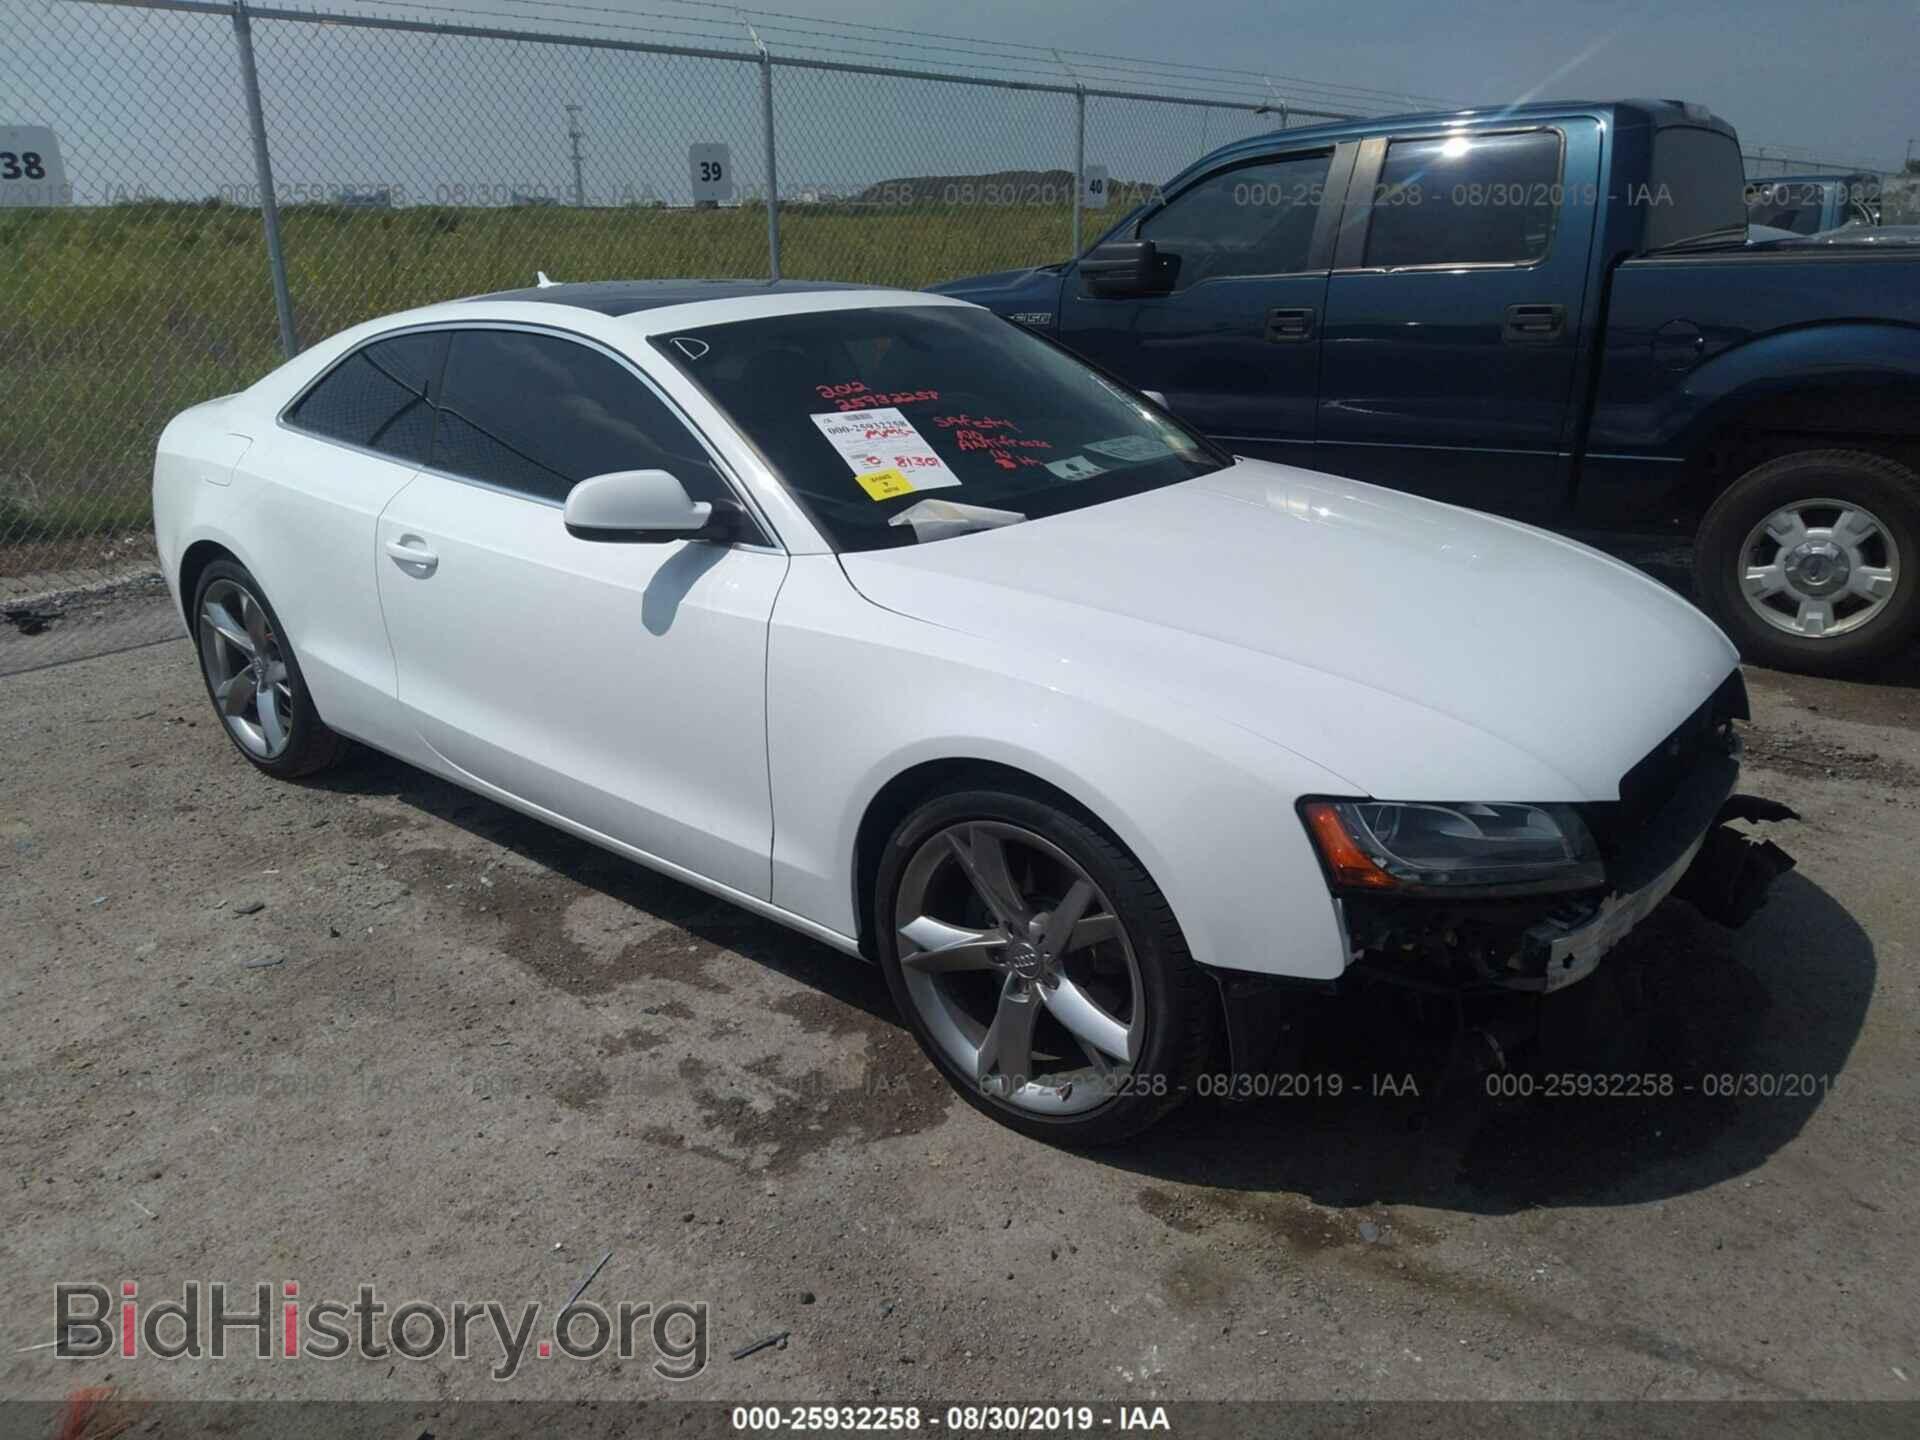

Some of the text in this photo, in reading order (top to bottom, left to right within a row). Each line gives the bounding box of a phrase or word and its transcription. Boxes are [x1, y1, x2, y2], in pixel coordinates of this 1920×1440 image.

[0, 152, 45, 179] 38
[700, 162, 722, 182] 39
[1089, 179, 1103, 194] 40
